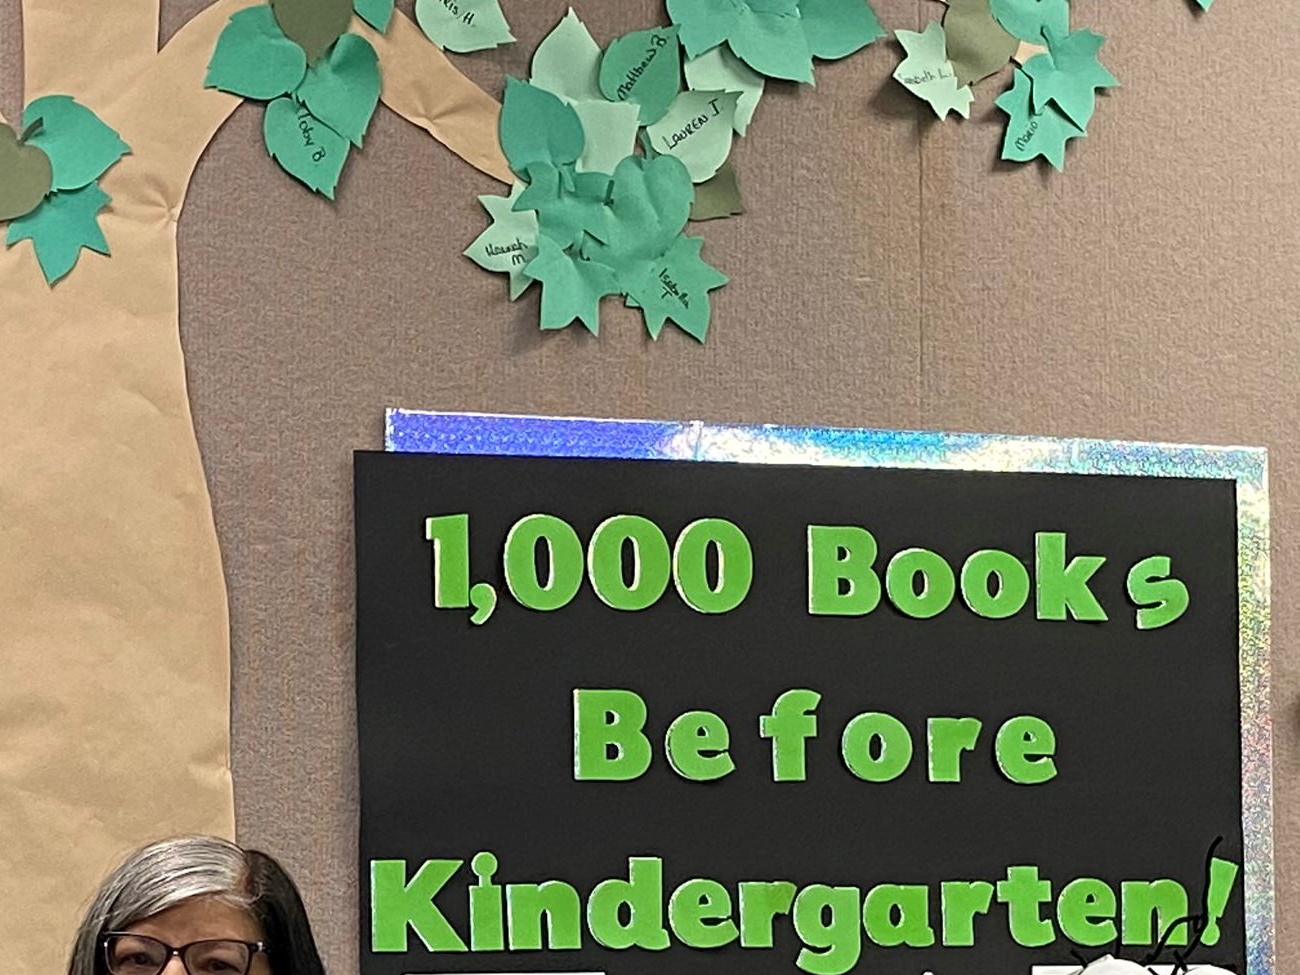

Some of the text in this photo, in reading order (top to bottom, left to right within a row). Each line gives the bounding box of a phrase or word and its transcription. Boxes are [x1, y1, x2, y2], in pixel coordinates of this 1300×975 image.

[425, 512, 1190, 630] 1,000 Books
[573, 688, 1059, 784] Before
